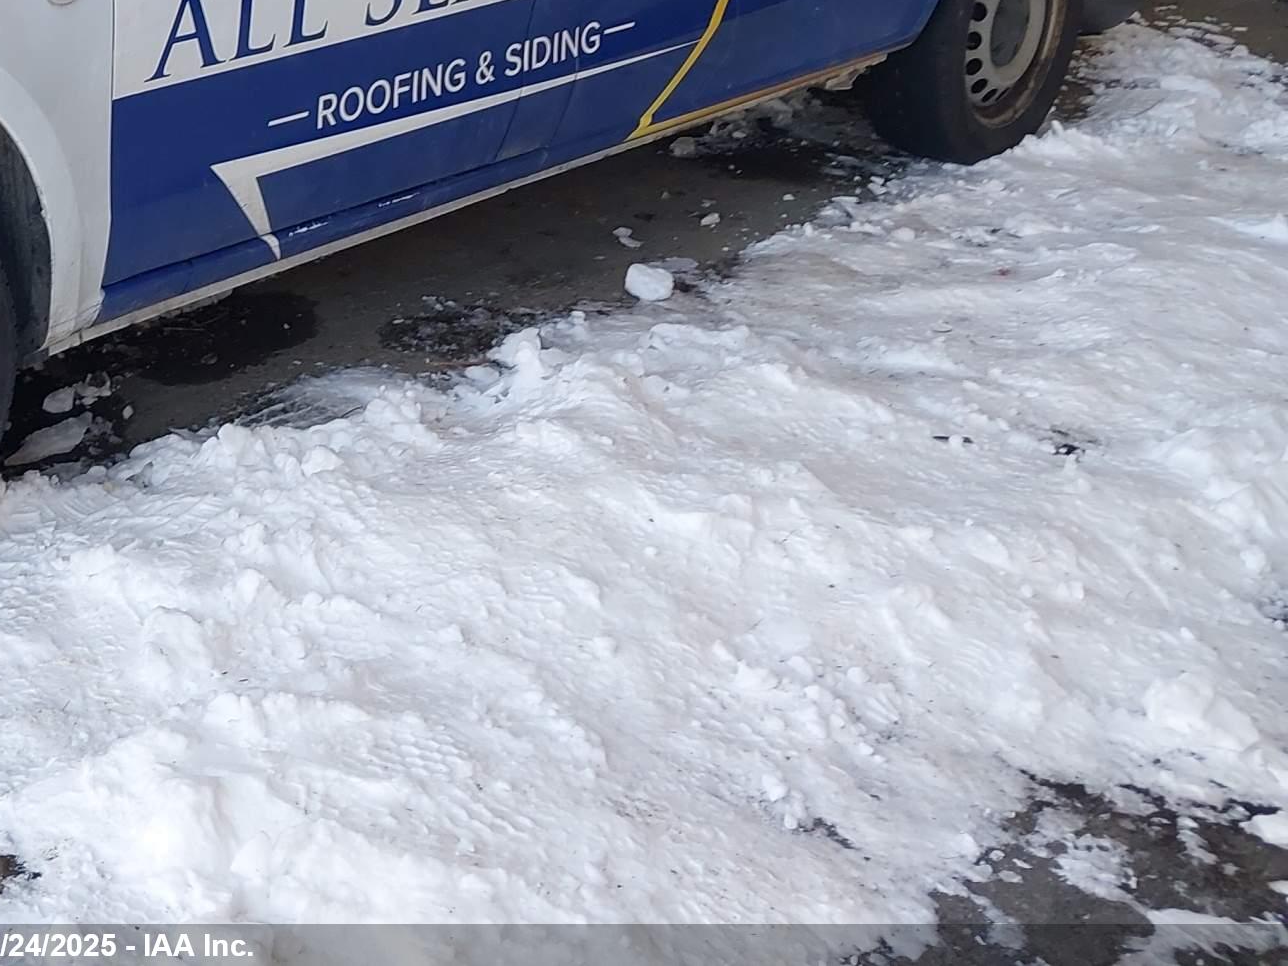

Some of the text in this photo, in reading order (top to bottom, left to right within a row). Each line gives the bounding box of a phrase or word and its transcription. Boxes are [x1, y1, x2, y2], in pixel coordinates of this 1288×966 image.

[316, 20, 602, 130] ROOFING & SIDING
